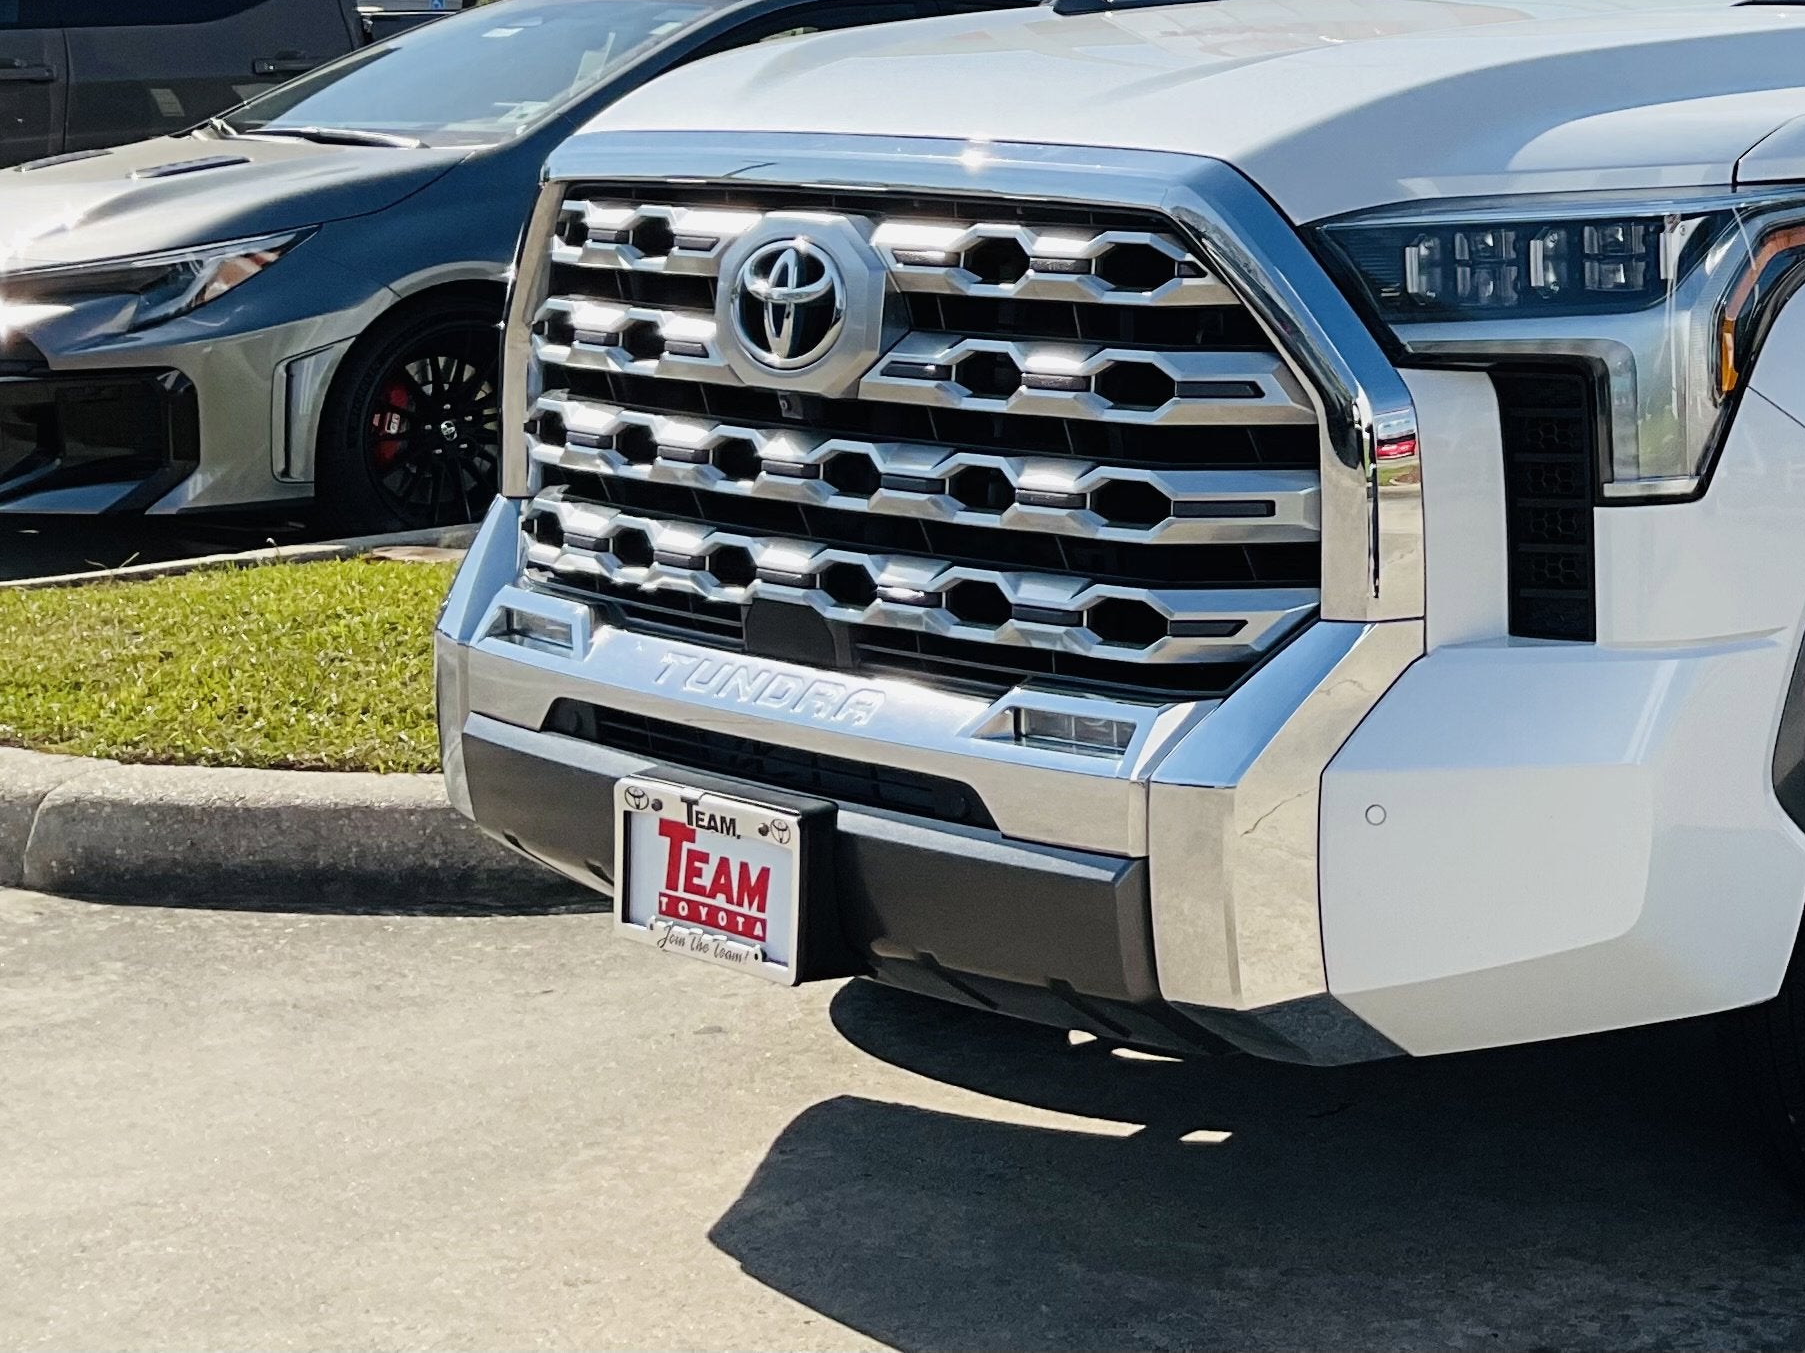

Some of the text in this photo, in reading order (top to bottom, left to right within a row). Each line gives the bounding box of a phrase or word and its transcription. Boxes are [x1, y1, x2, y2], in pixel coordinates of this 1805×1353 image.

[654, 651, 886, 727] TUNDRA
[658, 817, 771, 914] TEAM
[657, 924, 686, 949] Join
[659, 896, 764, 938] TOYOTA
